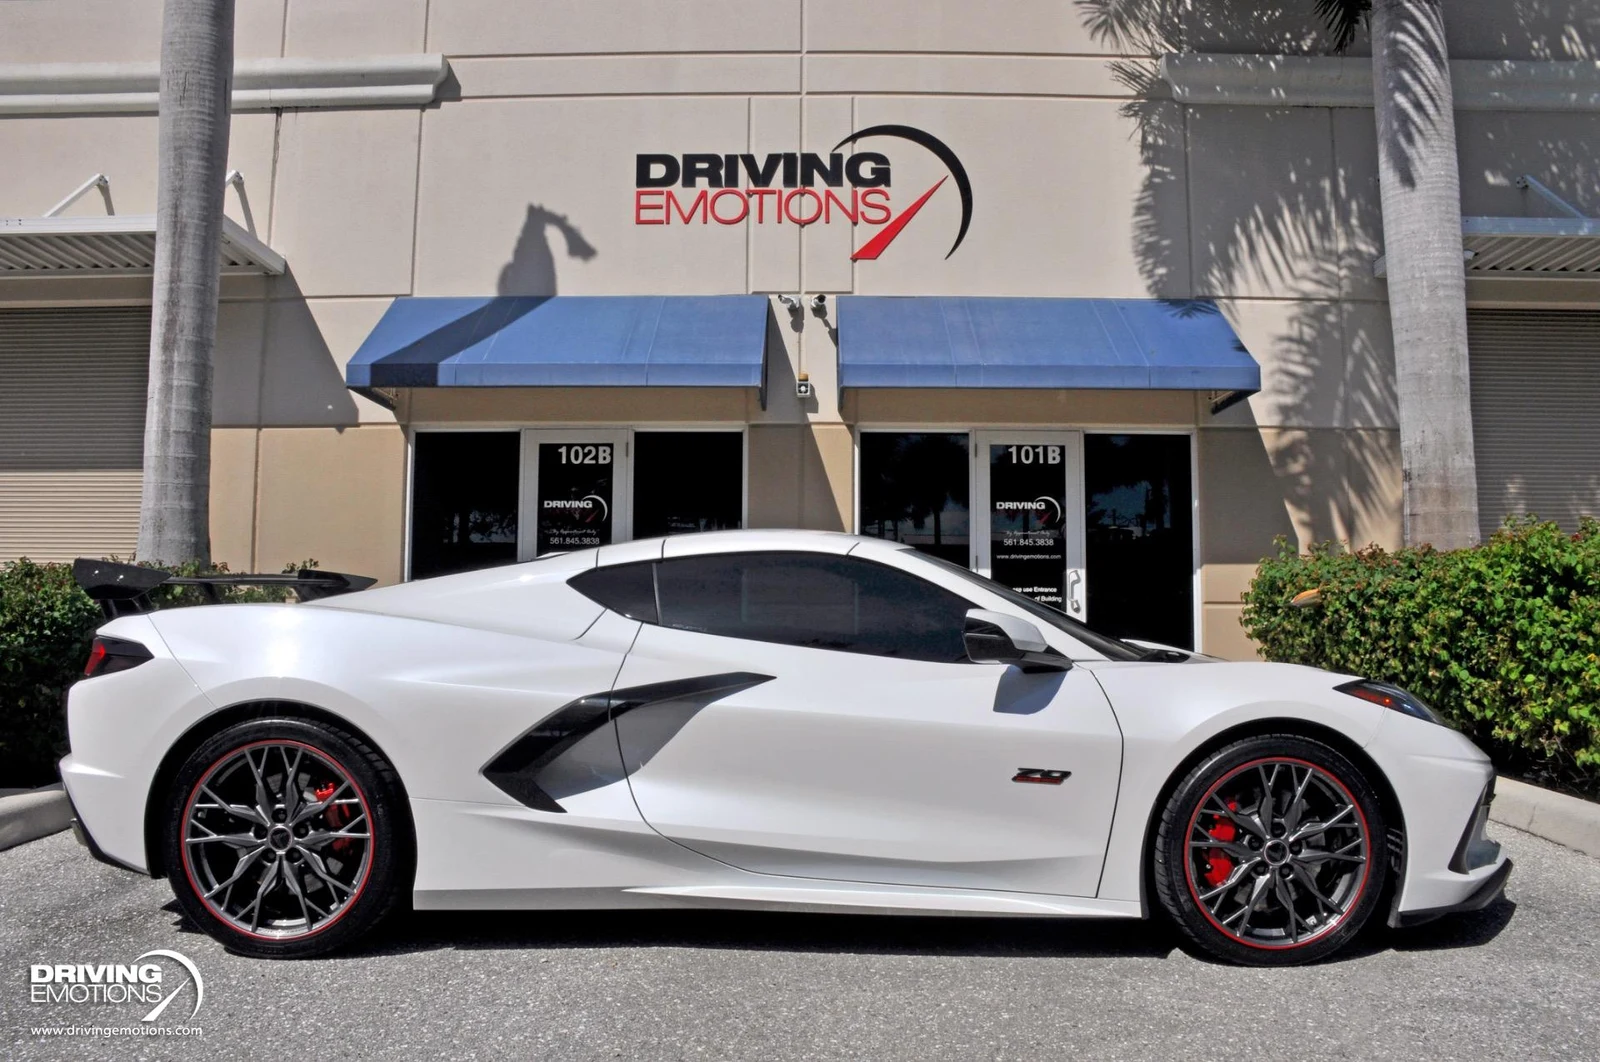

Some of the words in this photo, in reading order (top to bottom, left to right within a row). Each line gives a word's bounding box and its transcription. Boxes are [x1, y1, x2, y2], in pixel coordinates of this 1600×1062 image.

[636, 152, 891, 188] DRIVING
[635, 188, 892, 225] EMOTIONS
[558, 446, 612, 464] 102B
[1008, 445, 1061, 465] 101B
[543, 500, 593, 508] DRIVING
[996, 501, 1046, 510] DRIVING
[549, 536, 600, 545] 561.845.3838
[1003, 538, 1054, 546] 561.845.3838
[1041, 595, 1062, 603] Building
